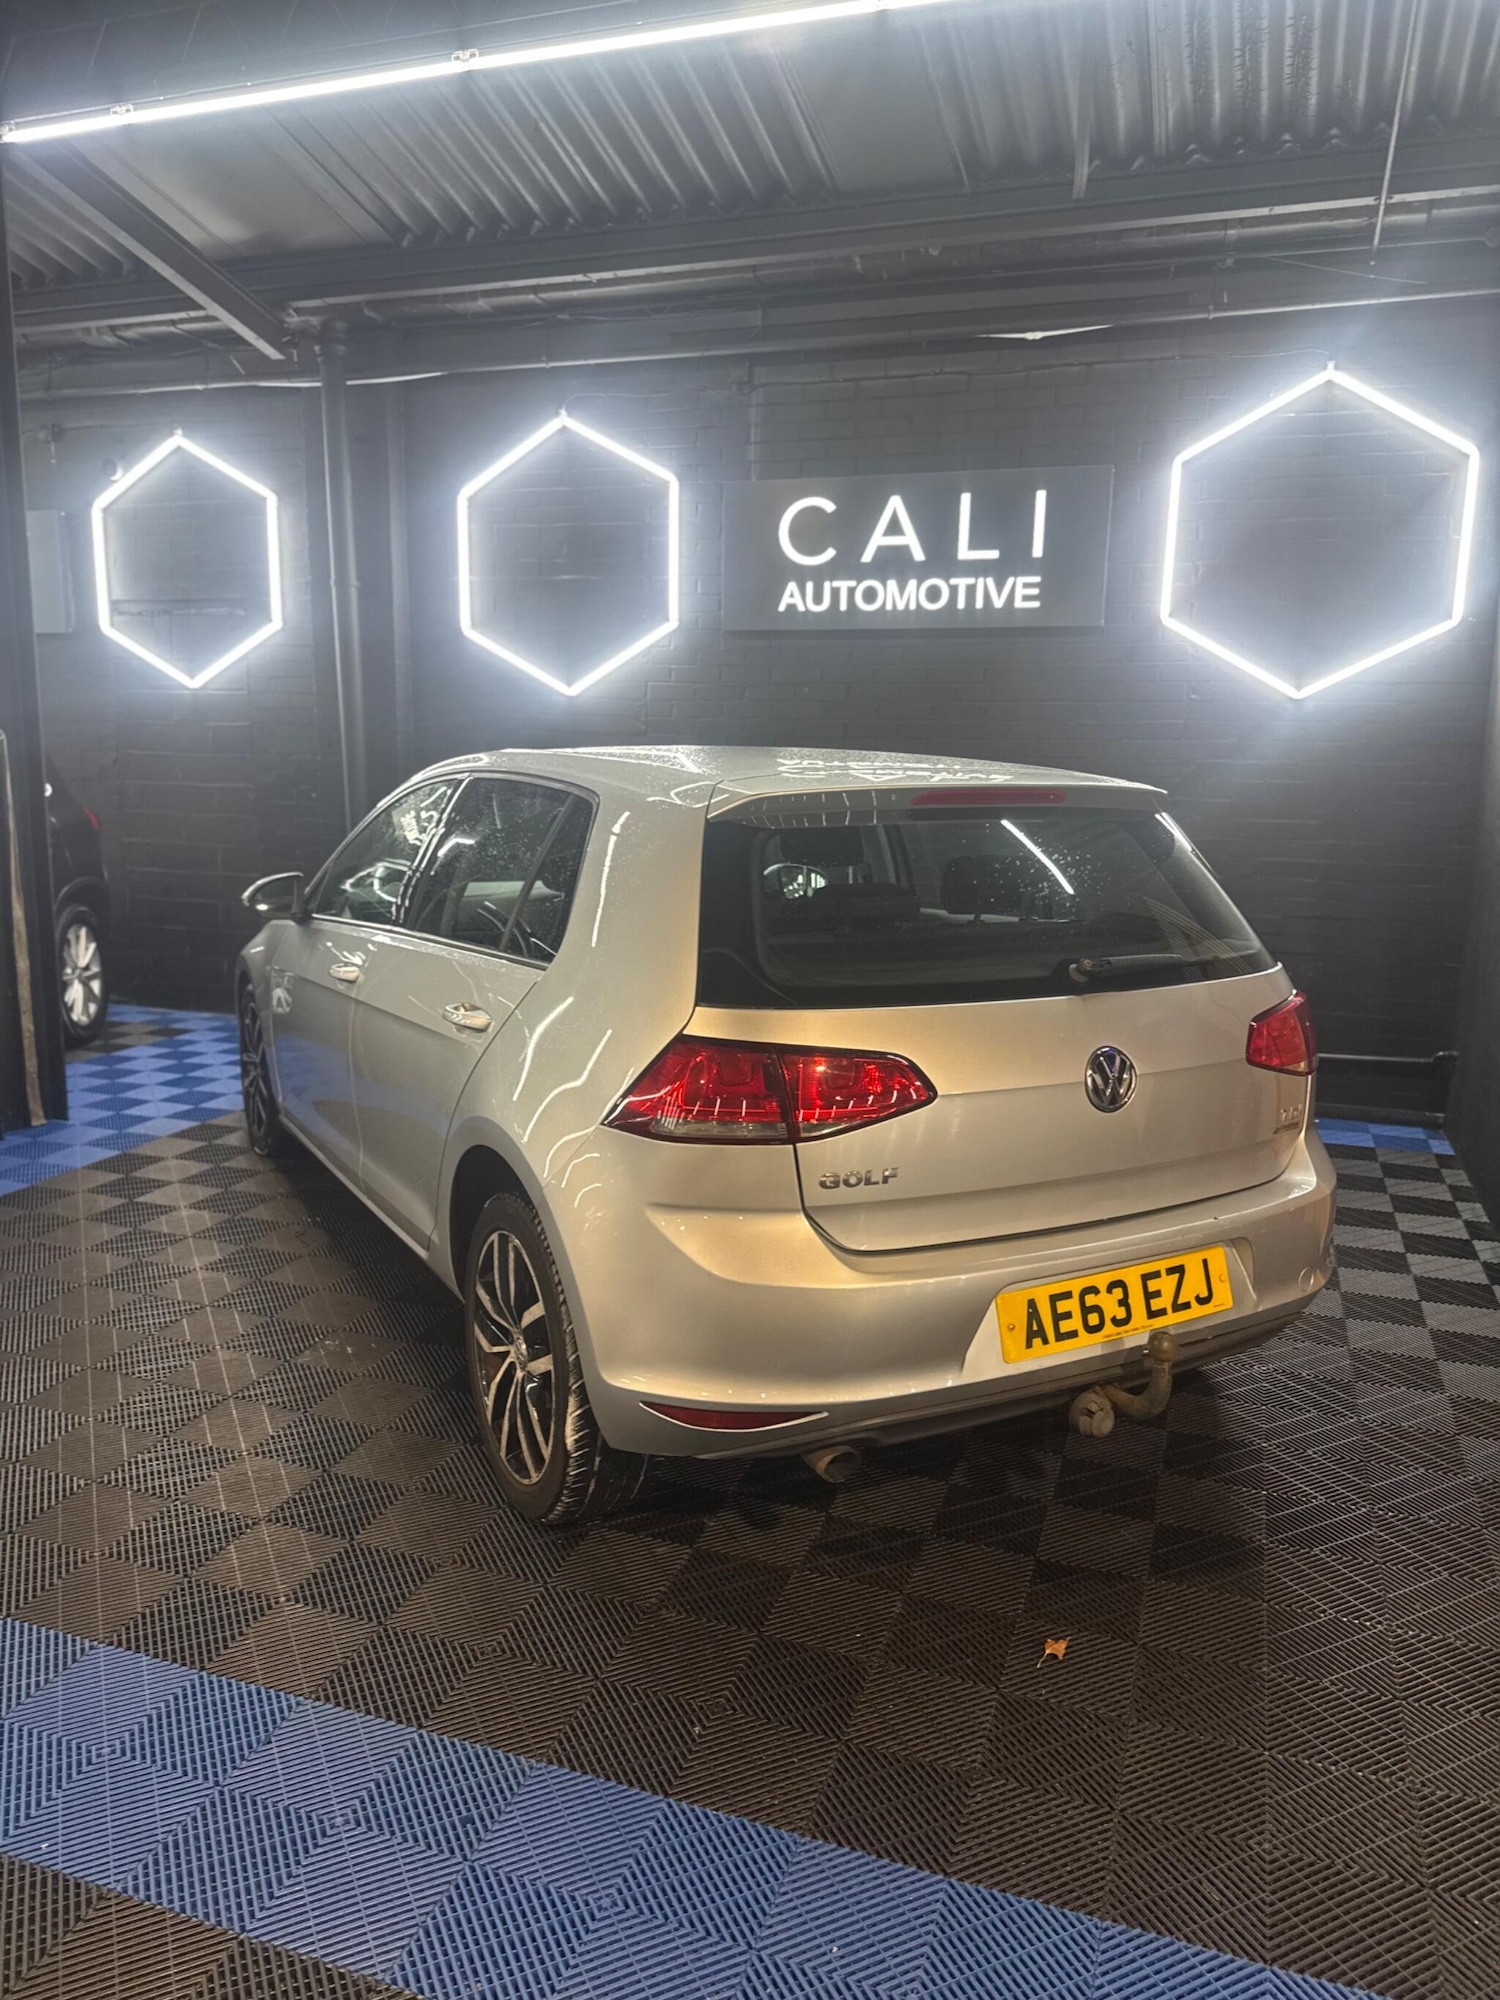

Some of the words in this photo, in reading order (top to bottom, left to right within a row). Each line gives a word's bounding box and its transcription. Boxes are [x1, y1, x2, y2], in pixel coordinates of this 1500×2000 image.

[778, 489, 1047, 566] CALI
[777, 575, 1042, 613] AUTOMOTIVE
[818, 1167, 899, 1190] GOLF
[1025, 1279, 1132, 1349] AE63
[1140, 1258, 1214, 1320] EZJ
